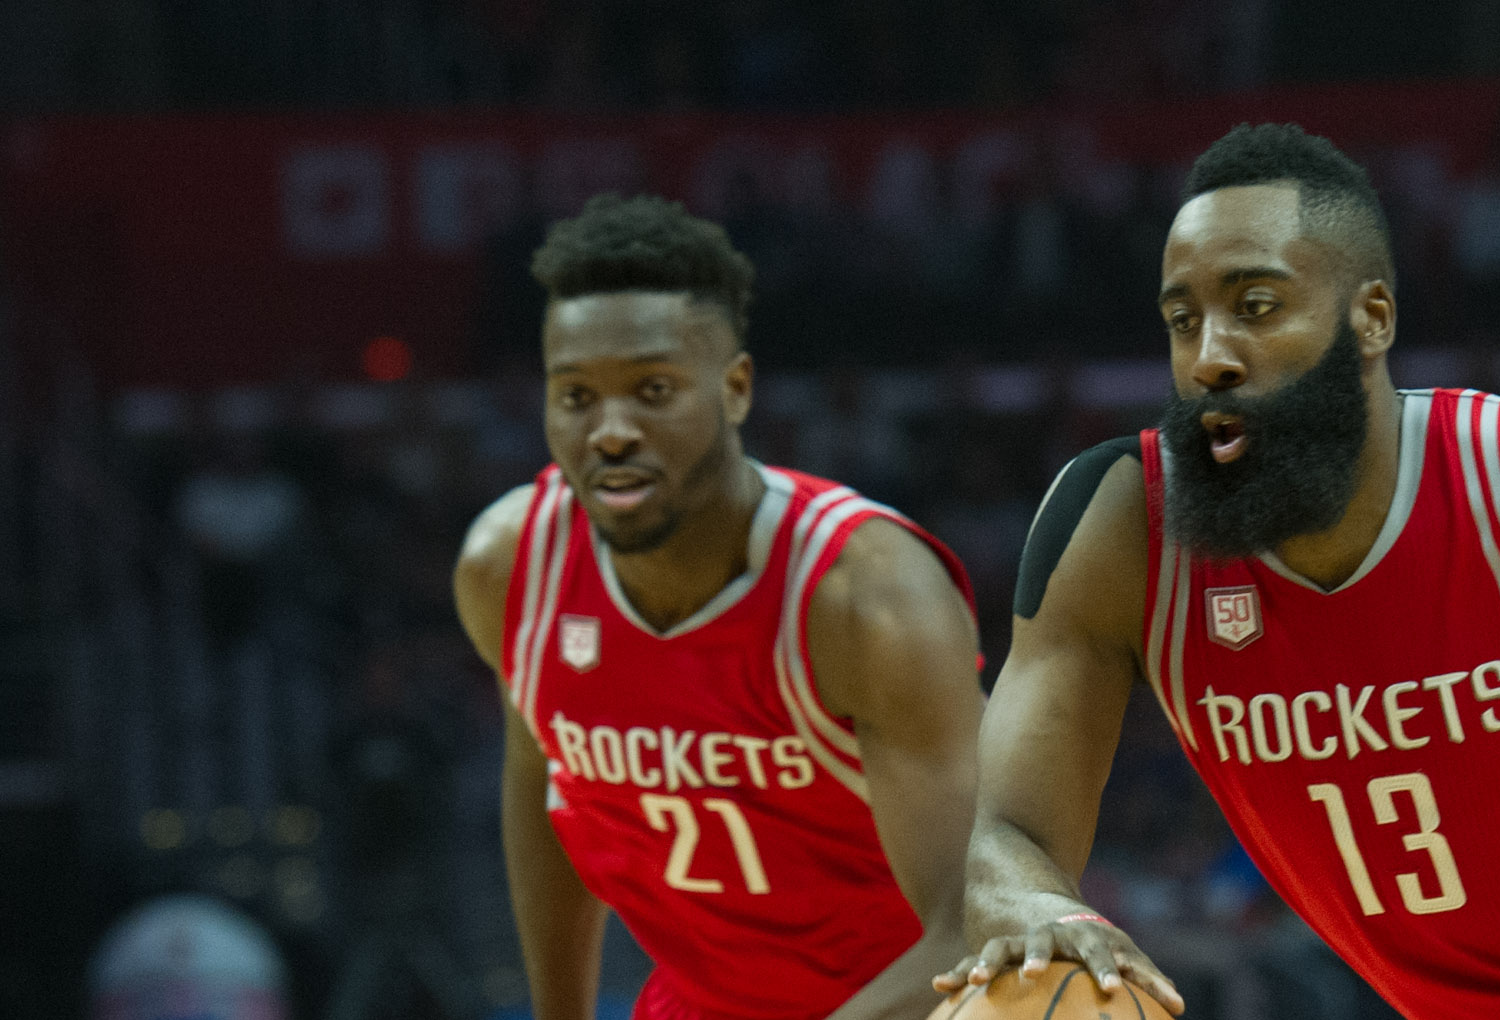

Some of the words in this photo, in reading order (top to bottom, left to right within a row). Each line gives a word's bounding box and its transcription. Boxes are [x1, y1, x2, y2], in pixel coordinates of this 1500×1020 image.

[1217, 595, 1250, 624] 50
[549, 711, 815, 792] ROCKETS
[639, 792, 771, 894] 21
[1307, 772, 1467, 917] 13
